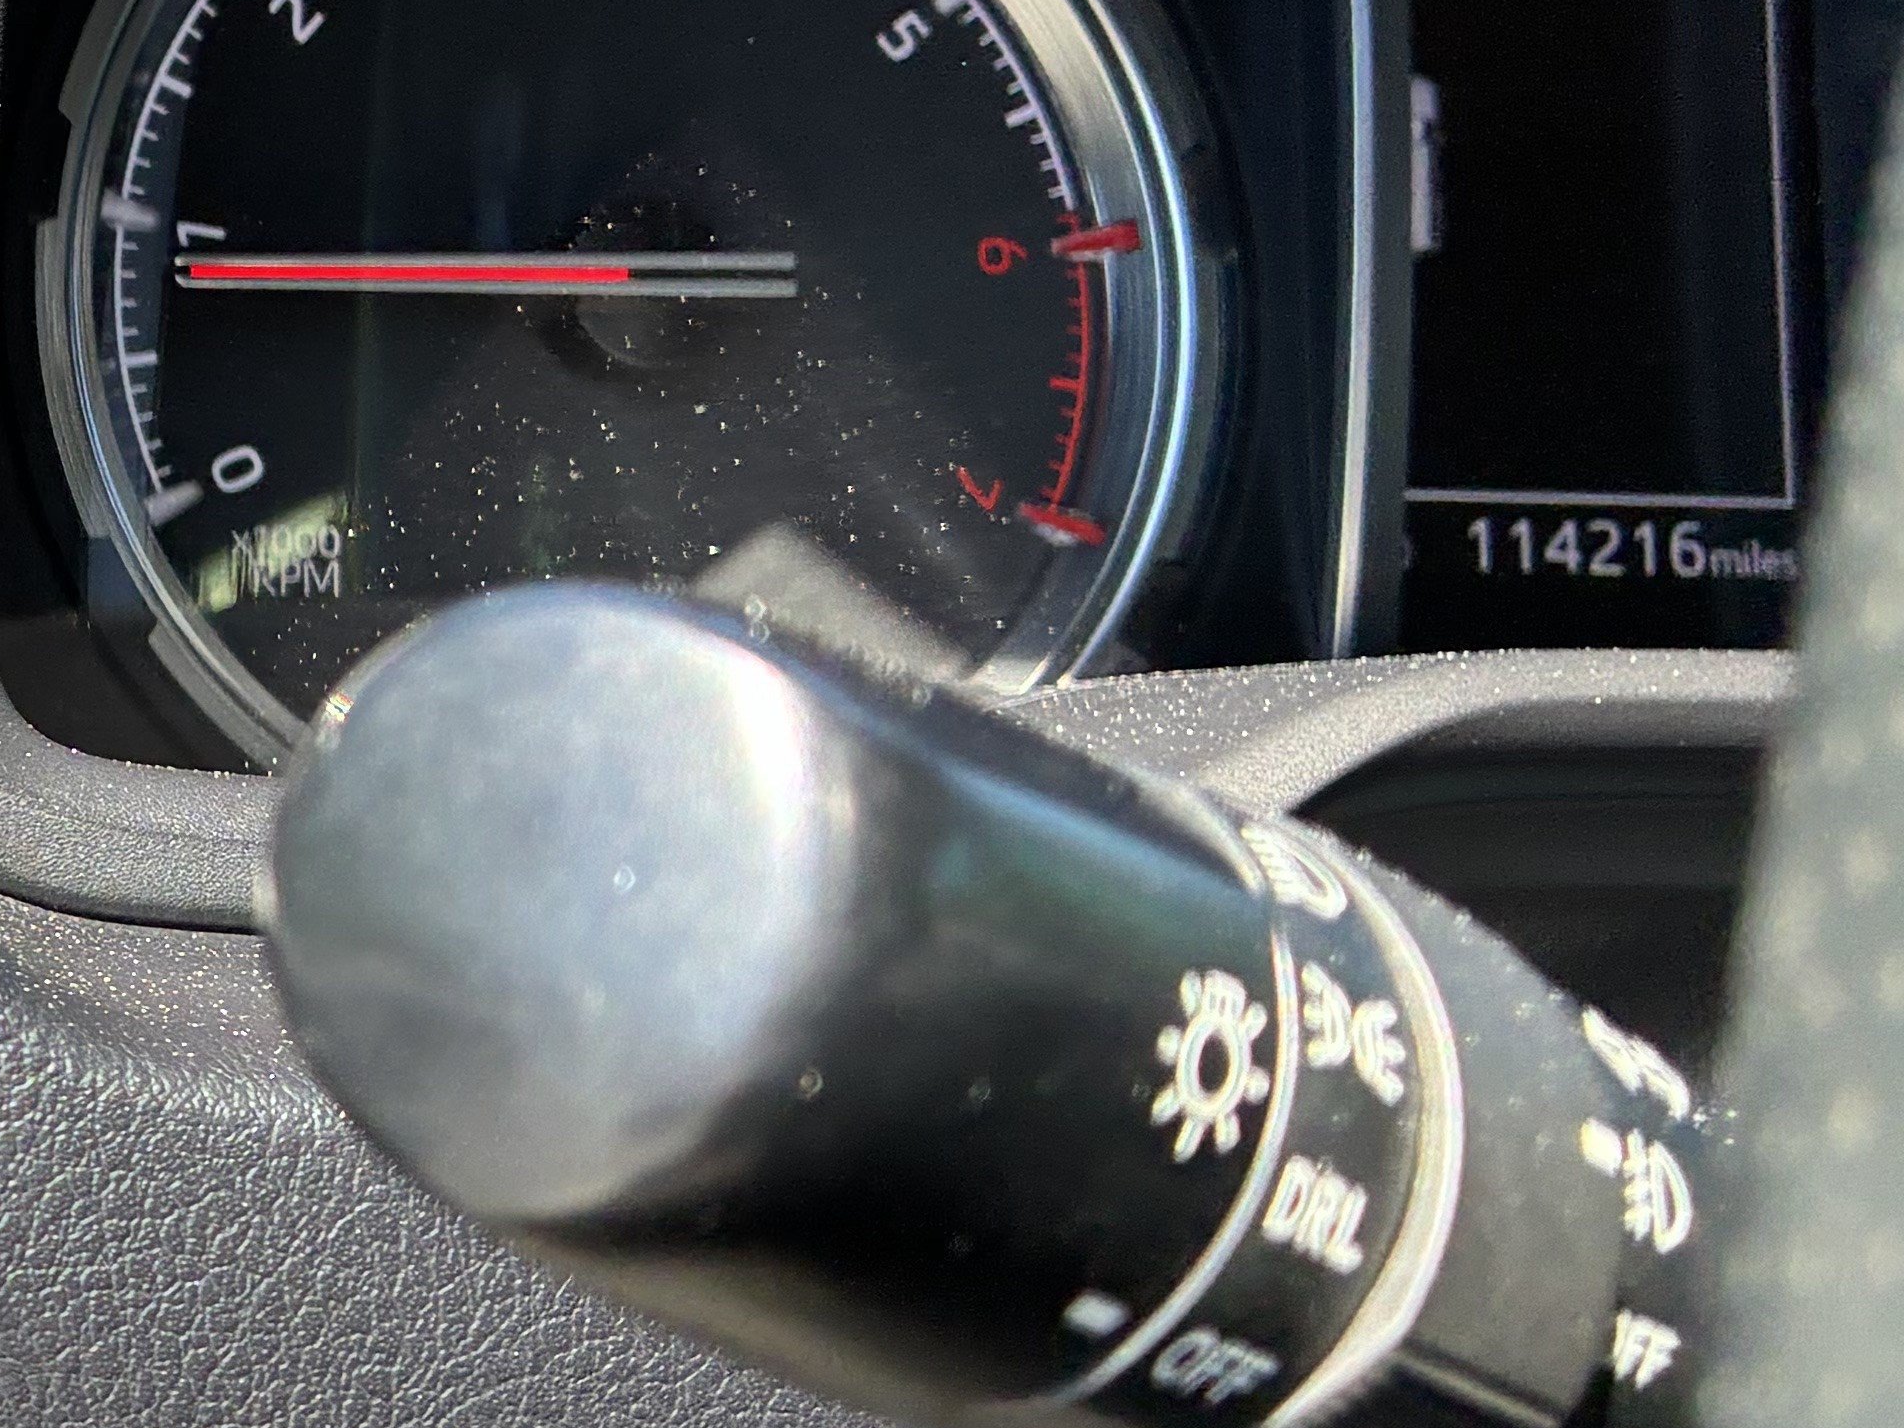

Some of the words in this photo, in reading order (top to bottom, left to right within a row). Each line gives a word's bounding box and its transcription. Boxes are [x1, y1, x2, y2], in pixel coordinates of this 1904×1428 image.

[875, 9, 933, 62] 5
[176, 220, 227, 247] 1
[977, 236, 1028, 275] 6
[211, 445, 264, 493] 0
[956, 466, 1003, 510] 7
[1467, 517, 1708, 579] 114216
[1149, 1325, 1282, 1406] OFF
